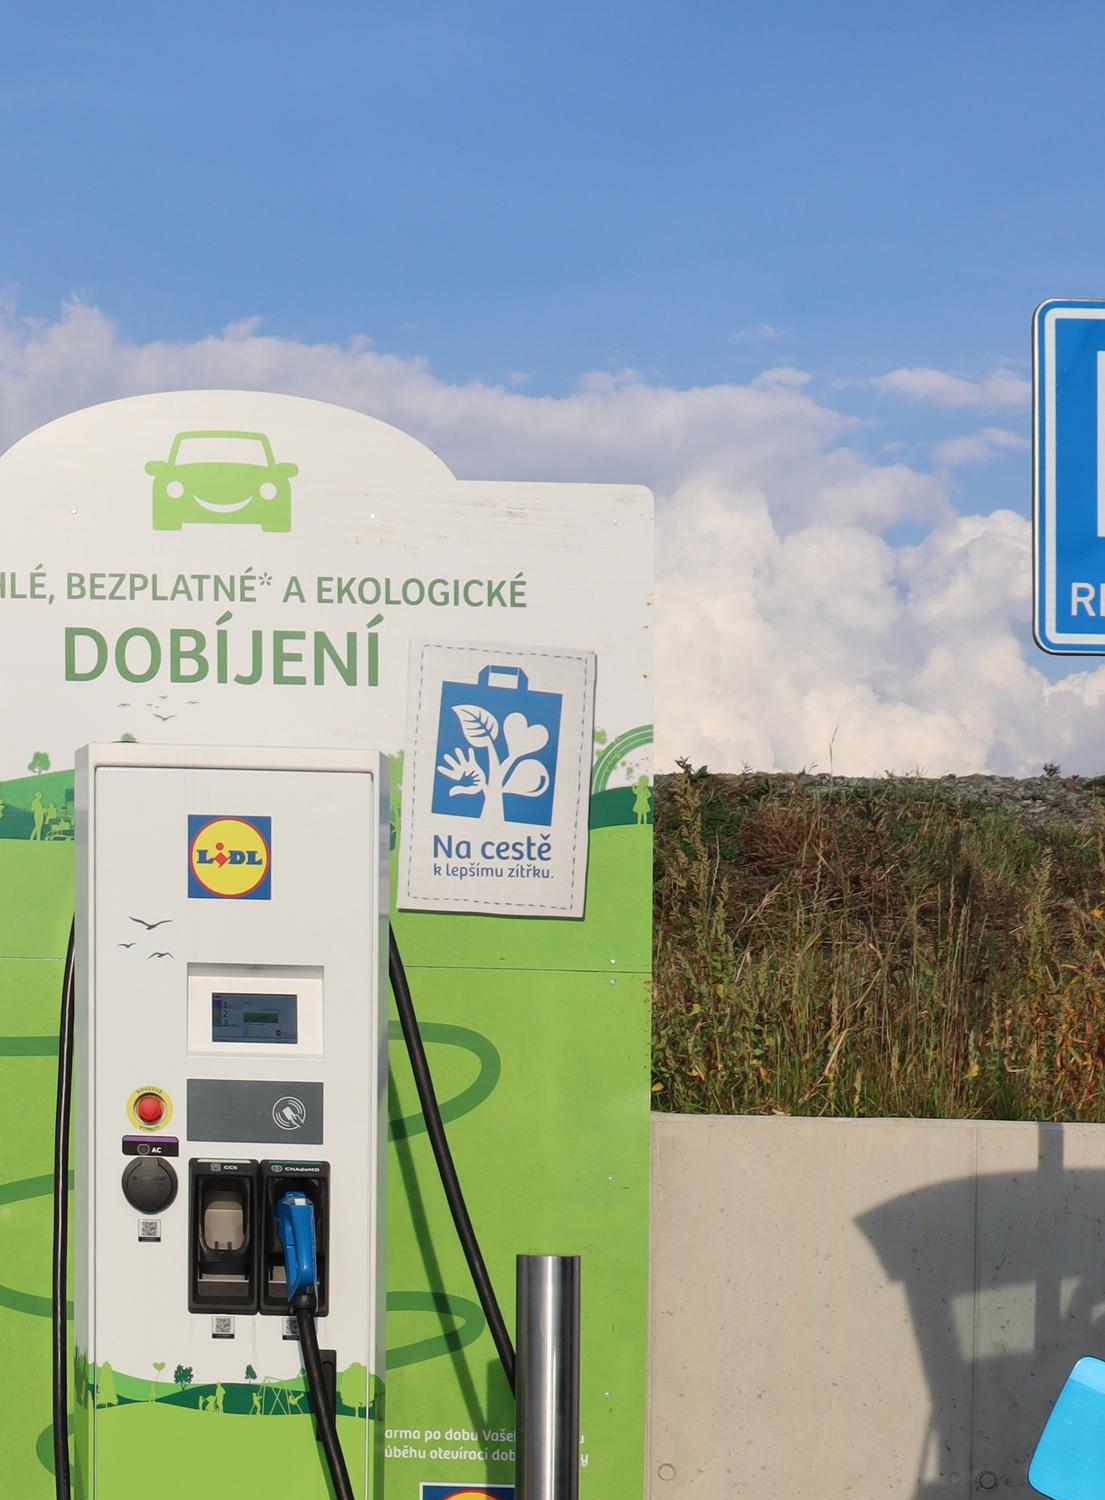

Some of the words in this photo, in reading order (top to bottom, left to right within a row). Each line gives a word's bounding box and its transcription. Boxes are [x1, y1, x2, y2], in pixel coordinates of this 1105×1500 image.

[282, 575, 307, 603] A
[316, 571, 528, 609] EKOLOGICKÉ
[1070, 581, 1105, 618] R
[64, 610, 385, 688] DOBÍJENÍ
[433, 834, 472, 859] Na
[480, 833, 552, 861] cestě
[433, 862, 442, 876] k
[446, 862, 504, 880] lepšímu
[151, 1146, 162, 1154] AC
[424, 1430, 441, 1443] po
[445, 1428, 479, 1441] dobu
[482, 1427, 516, 1442] Vaše
[430, 1446, 489, 1461] otevírací
